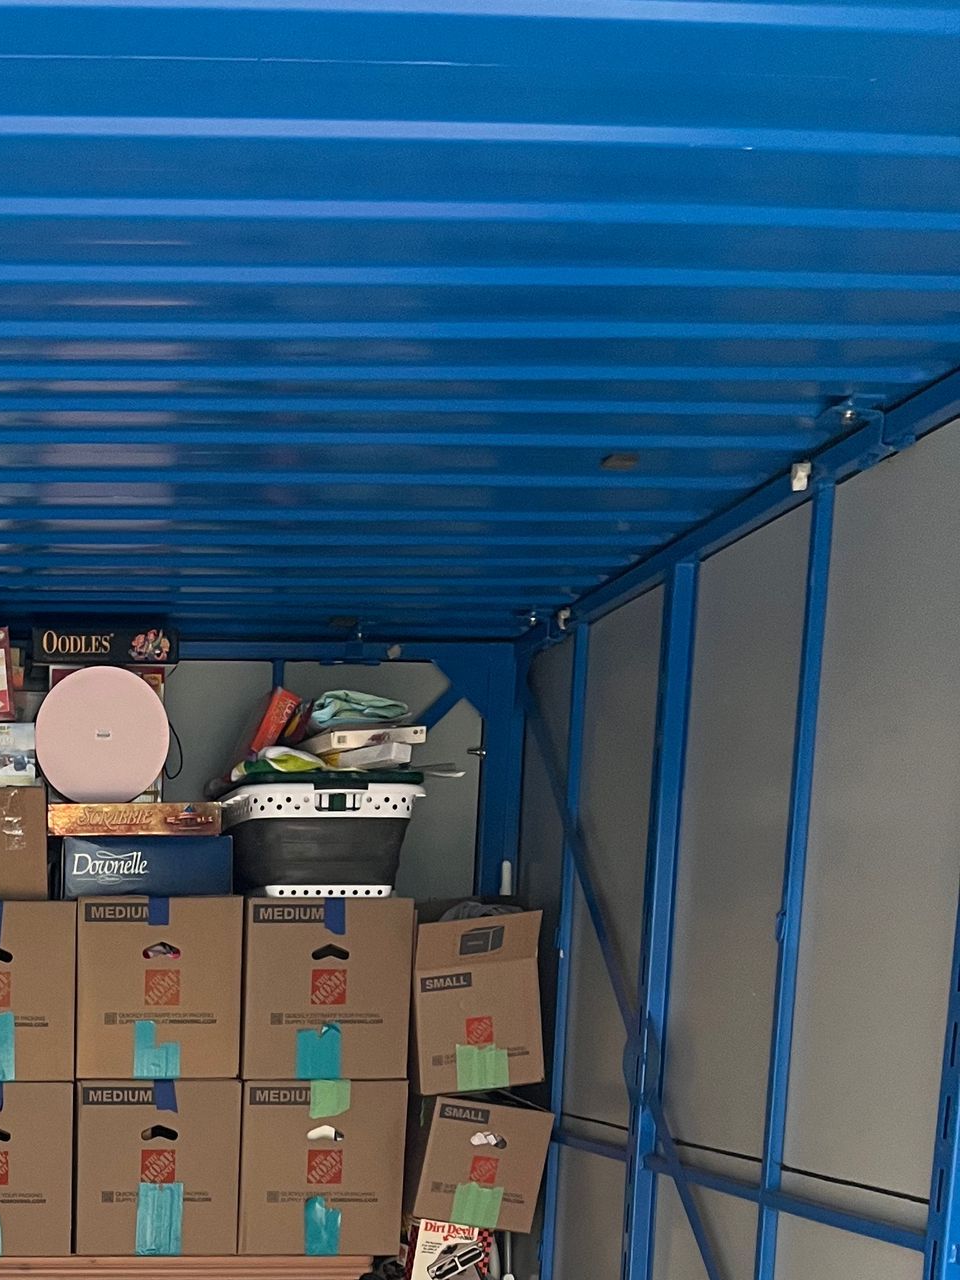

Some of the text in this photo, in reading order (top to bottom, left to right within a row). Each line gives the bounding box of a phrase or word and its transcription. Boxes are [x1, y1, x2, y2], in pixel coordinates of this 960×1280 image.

[42, 630, 110, 654] OODLES
[72, 850, 148, 875] Downelle
[260, 908, 324, 920] MEDIUM
[425, 976, 468, 990] SMALL
[89, 1090, 152, 1102] MEDIUM
[256, 1090, 311, 1102] MEDIU
[444, 1106, 484, 1121] SMALL
[424, 1222, 474, 1236] Dirt Devil
